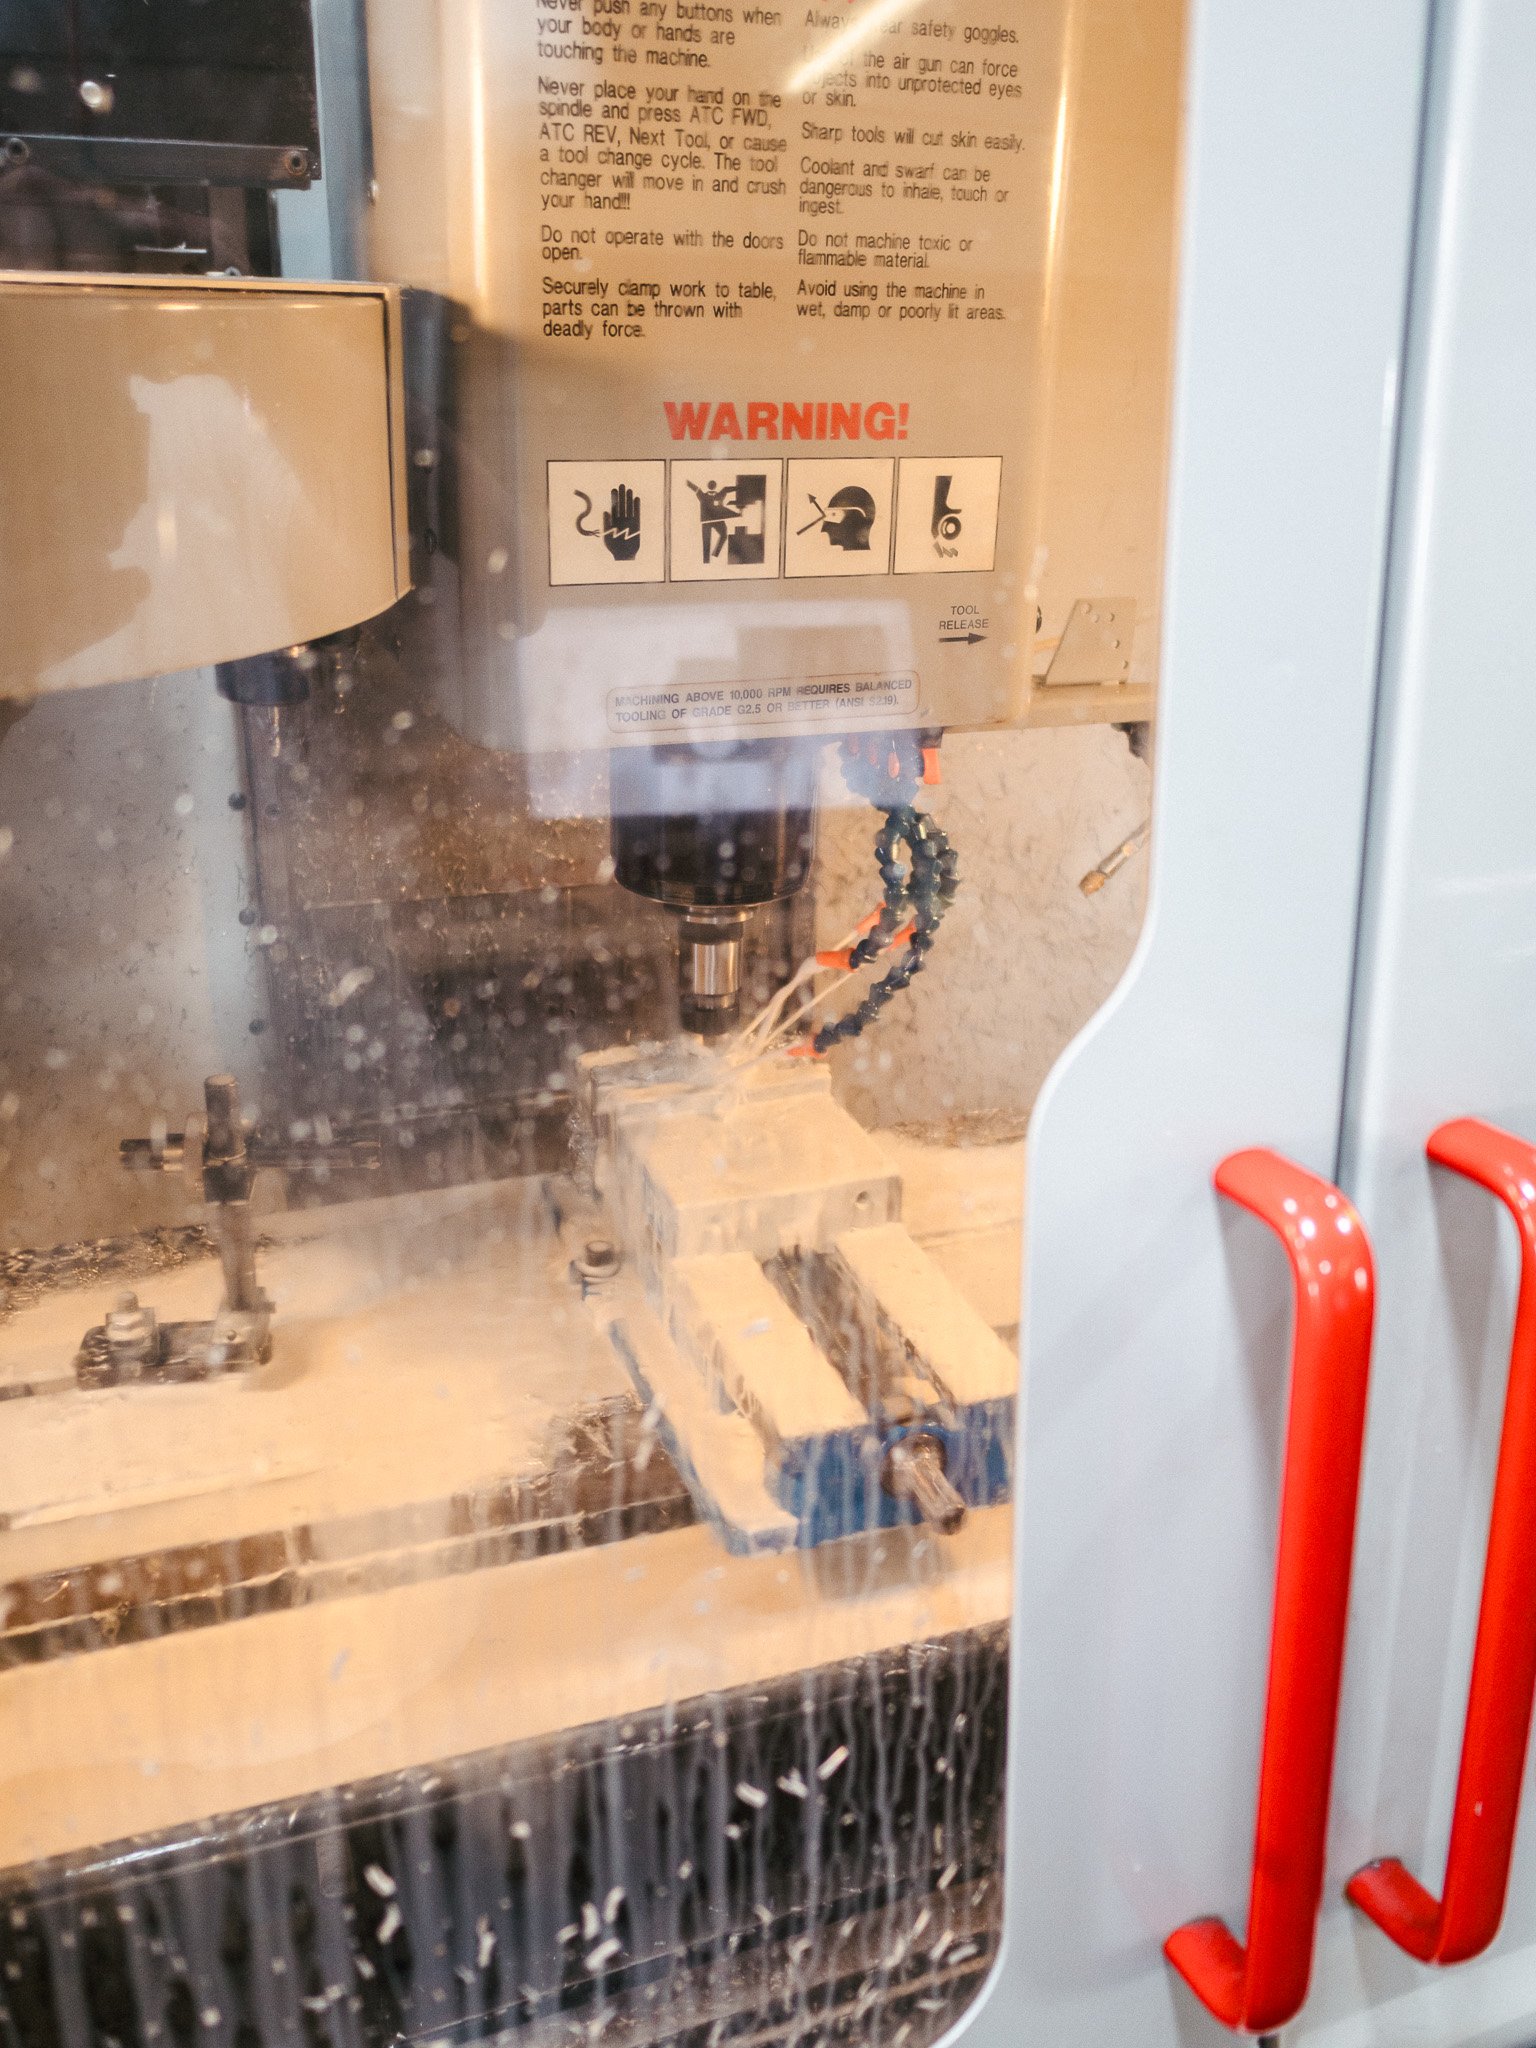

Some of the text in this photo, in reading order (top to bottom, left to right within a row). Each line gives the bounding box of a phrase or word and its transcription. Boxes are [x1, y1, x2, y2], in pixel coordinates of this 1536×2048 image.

[593, 0, 629, 15] push
[640, 1, 666, 20] any
[677, 1, 733, 23] buttons
[743, 8, 781, 25] when
[538, 16, 735, 45] your body or hands are
[805, 10, 854, 31] Alway
[912, 21, 955, 42] safety
[964, 25, 1019, 45] goggles.
[538, 40, 711, 68] touching the machine.
[864, 53, 884, 68] the
[894, 53, 911, 69] air
[919, 57, 941, 74] gun
[951, 60, 974, 74] can
[983, 59, 1017, 78] force
[538, 76, 781, 108] Never place your hand on the
[801, 70, 1022, 100] jects into unprotected eyes
[803, 89, 856, 107] or skin.
[539, 100, 772, 130] spindle and press ATC FWD,
[540, 123, 787, 152] ATC REV, Next Tool, or cause
[802, 121, 1025, 154] Sharp tools will cut skin easily.
[540, 146, 778, 172] a tool change cycle. The tool
[800, 156, 990, 182] Coolant and swarf can be
[541, 168, 786, 195] changer will move in and crush
[800, 178, 1009, 203] dangerous to inhale, touch or
[541, 193, 574, 211] your
[799, 197, 844, 216] ingest.
[541, 225, 783, 249] Do not operate with the doors
[799, 230, 973, 251] Do not machine toxic or
[542, 245, 583, 264] open.
[799, 249, 929, 268] flammable material.
[543, 277, 776, 302] Securely clamp work to table,
[797, 279, 985, 300] Avoid using the machine in
[543, 300, 742, 319] parts can be thrown with
[797, 301, 1005, 321] wet, damp or poorly lit areas.
[543, 320, 646, 340] deadly force.
[663, 401, 910, 440] WARNING!
[950, 605, 979, 615] TOOL
[938, 618, 989, 629] RELEASE
[616, 680, 912, 706] MACHINING ABOVE 10,000 RPM REQUIRES BALANCED
[616, 710, 666, 722] TOOLING
[672, 708, 687, 718] OF
[693, 706, 731, 716] GRADE
[737, 703, 761, 715] G2.5
[767, 703, 782, 712] OR
[788, 700, 829, 711] BETTER
[835, 698, 864, 709] (ANSI
